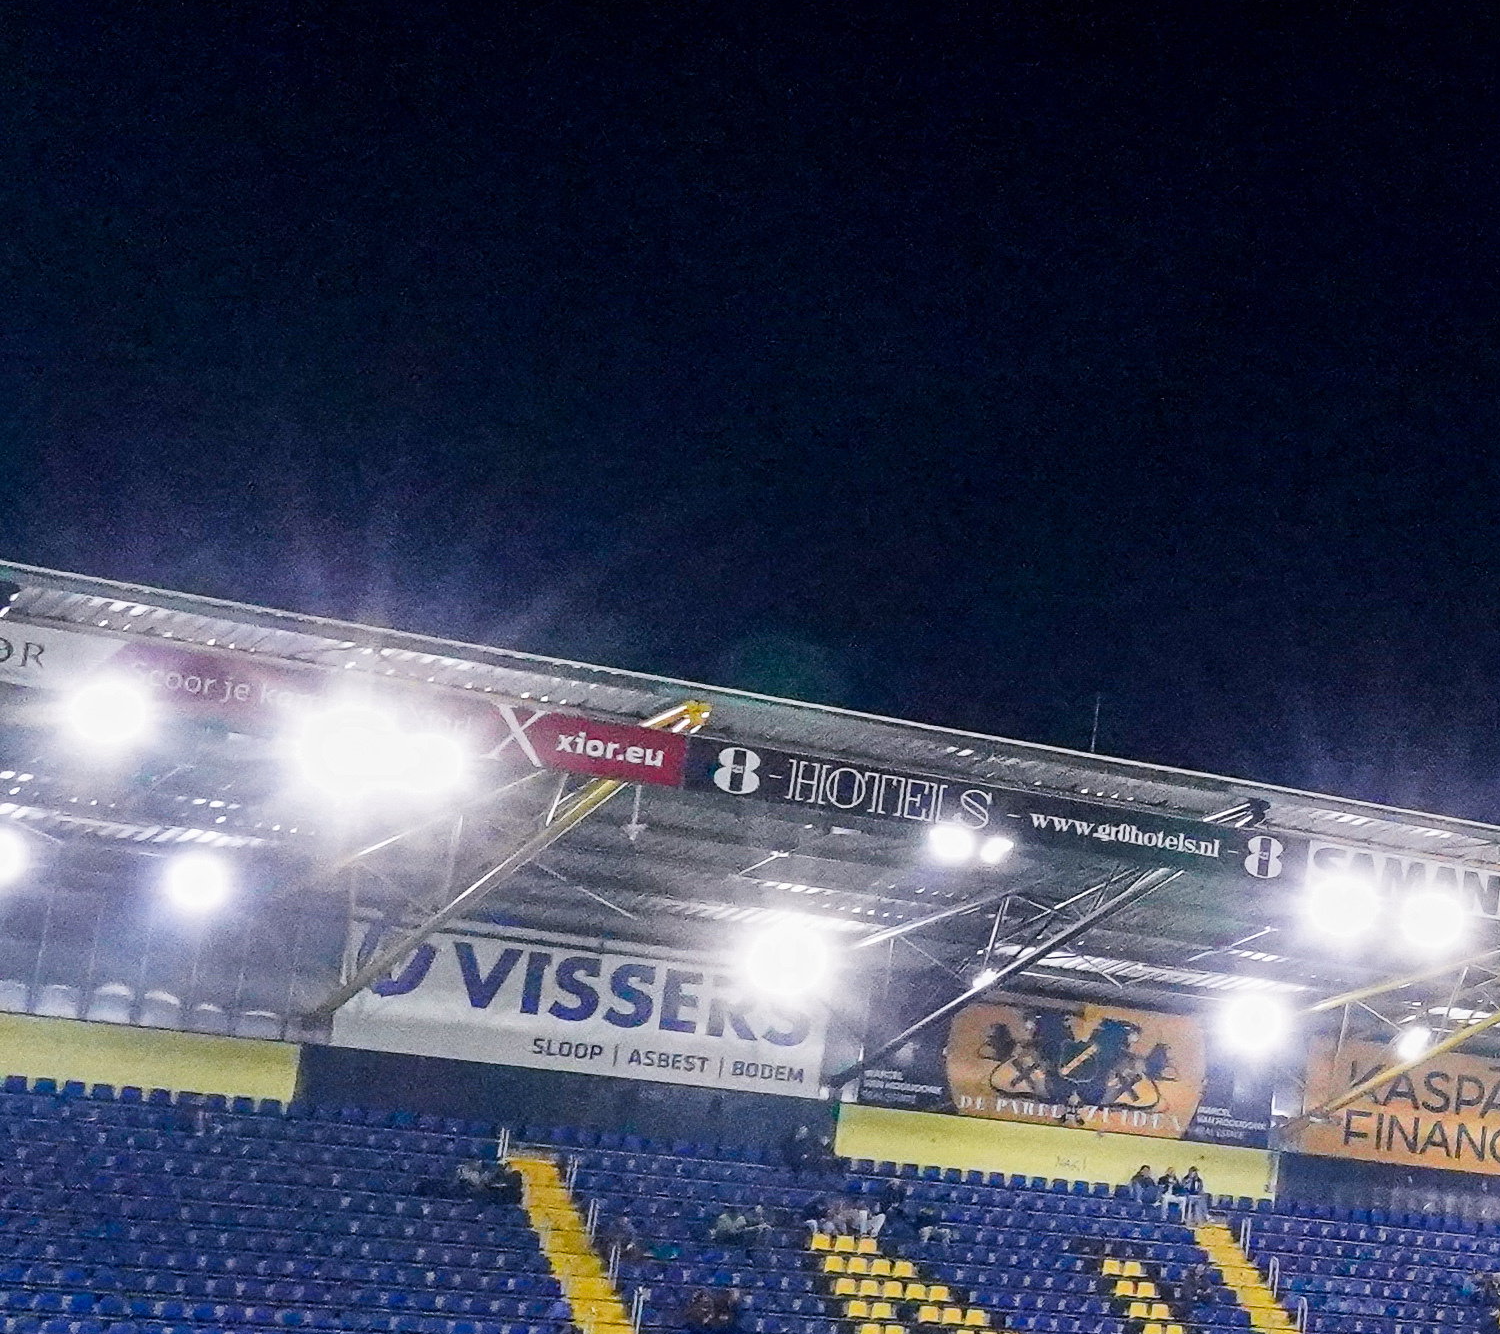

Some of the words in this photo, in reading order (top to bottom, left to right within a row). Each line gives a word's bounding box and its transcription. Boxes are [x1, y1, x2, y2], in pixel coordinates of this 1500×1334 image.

[219, 673, 251, 704] je
[556, 731, 666, 767] xior.eu
[784, 758, 993, 830] HOTELS
[453, 941, 812, 1047] VISSERS
[532, 1037, 604, 1062] SLOOP
[628, 1049, 711, 1074] ASBEST
[731, 1061, 805, 1084] BODEM
